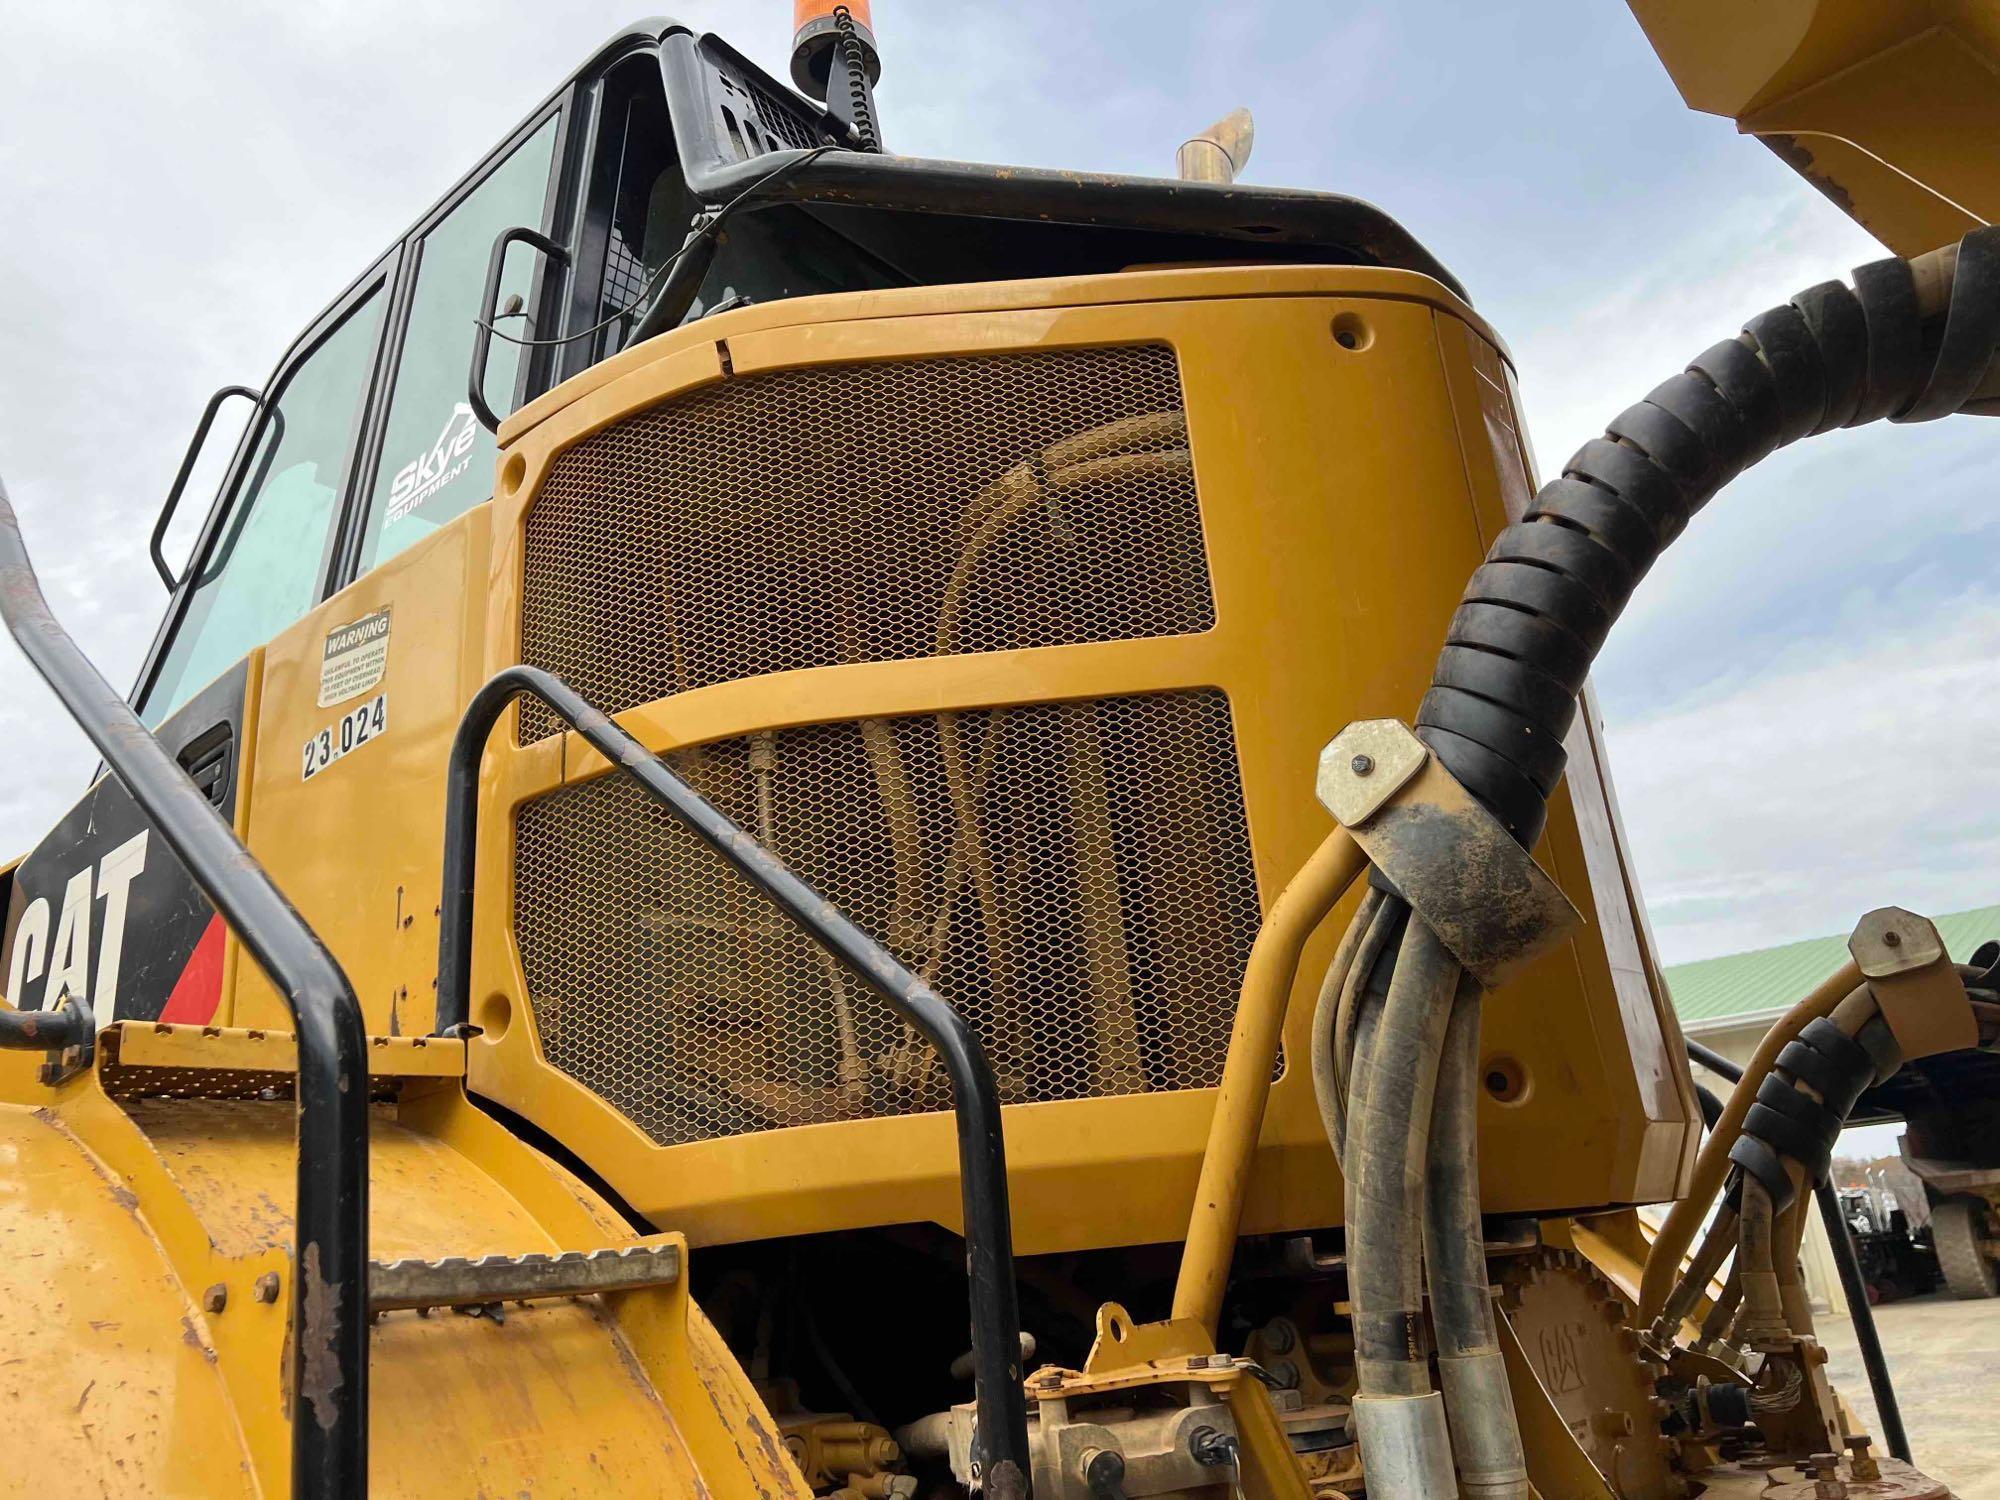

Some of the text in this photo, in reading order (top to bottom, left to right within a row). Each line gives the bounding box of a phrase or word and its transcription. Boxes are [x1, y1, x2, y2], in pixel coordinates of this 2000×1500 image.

[384, 455, 473, 530] EQUIPMENT
[327, 616, 388, 654] WARNING
[334, 665, 364, 681] EQUIPMENT
[366, 656, 384, 669] WITHIN
[361, 647, 384, 661] OPERATE
[331, 680, 344, 690] FEET
[353, 666, 380, 682] OVERHEAD
[338, 683, 360, 696] VOLTAGE
[362, 676, 378, 688] LINES
[304, 696, 385, 779] 23.024
[7, 828, 149, 1034] CAT
